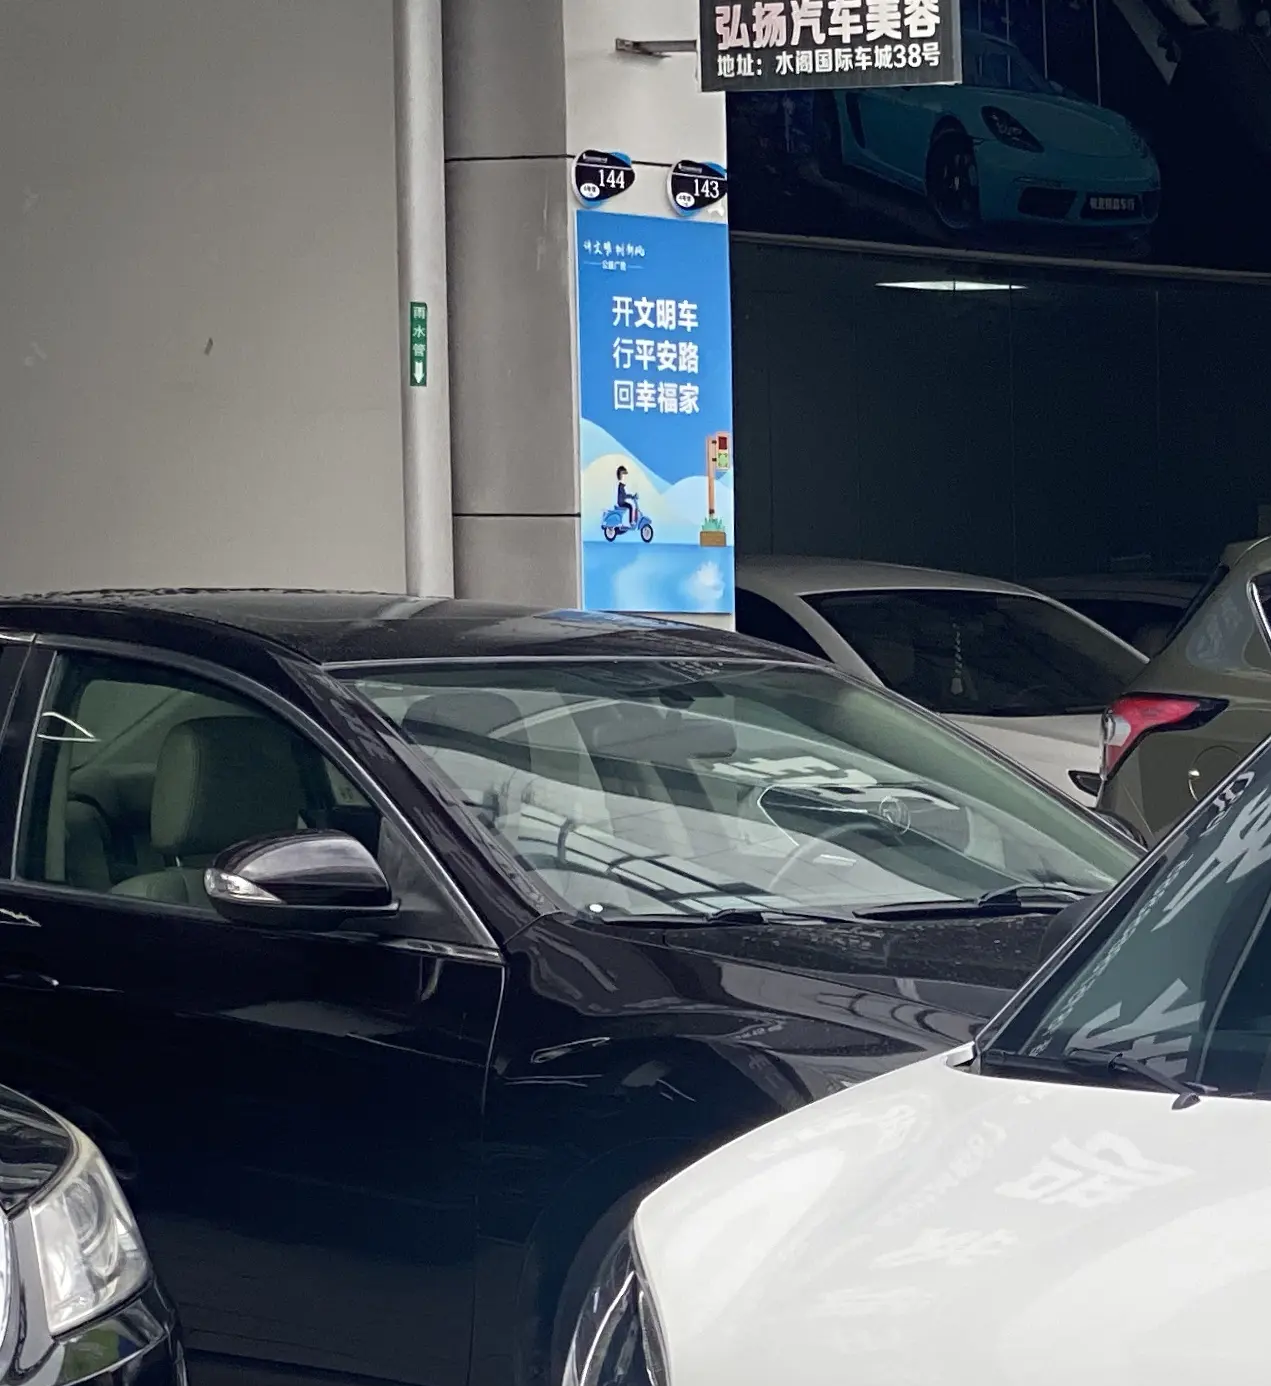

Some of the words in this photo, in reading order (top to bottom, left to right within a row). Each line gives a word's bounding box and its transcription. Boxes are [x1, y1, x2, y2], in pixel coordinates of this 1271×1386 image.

[715, 0, 940, 50] 弘扬汽车美容
[598, 169, 625, 189] 144
[693, 179, 720, 199] 143
[612, 296, 699, 332] 开文明车
[612, 337, 699, 374] 行平安路
[613, 379, 700, 415] 回幸福家
